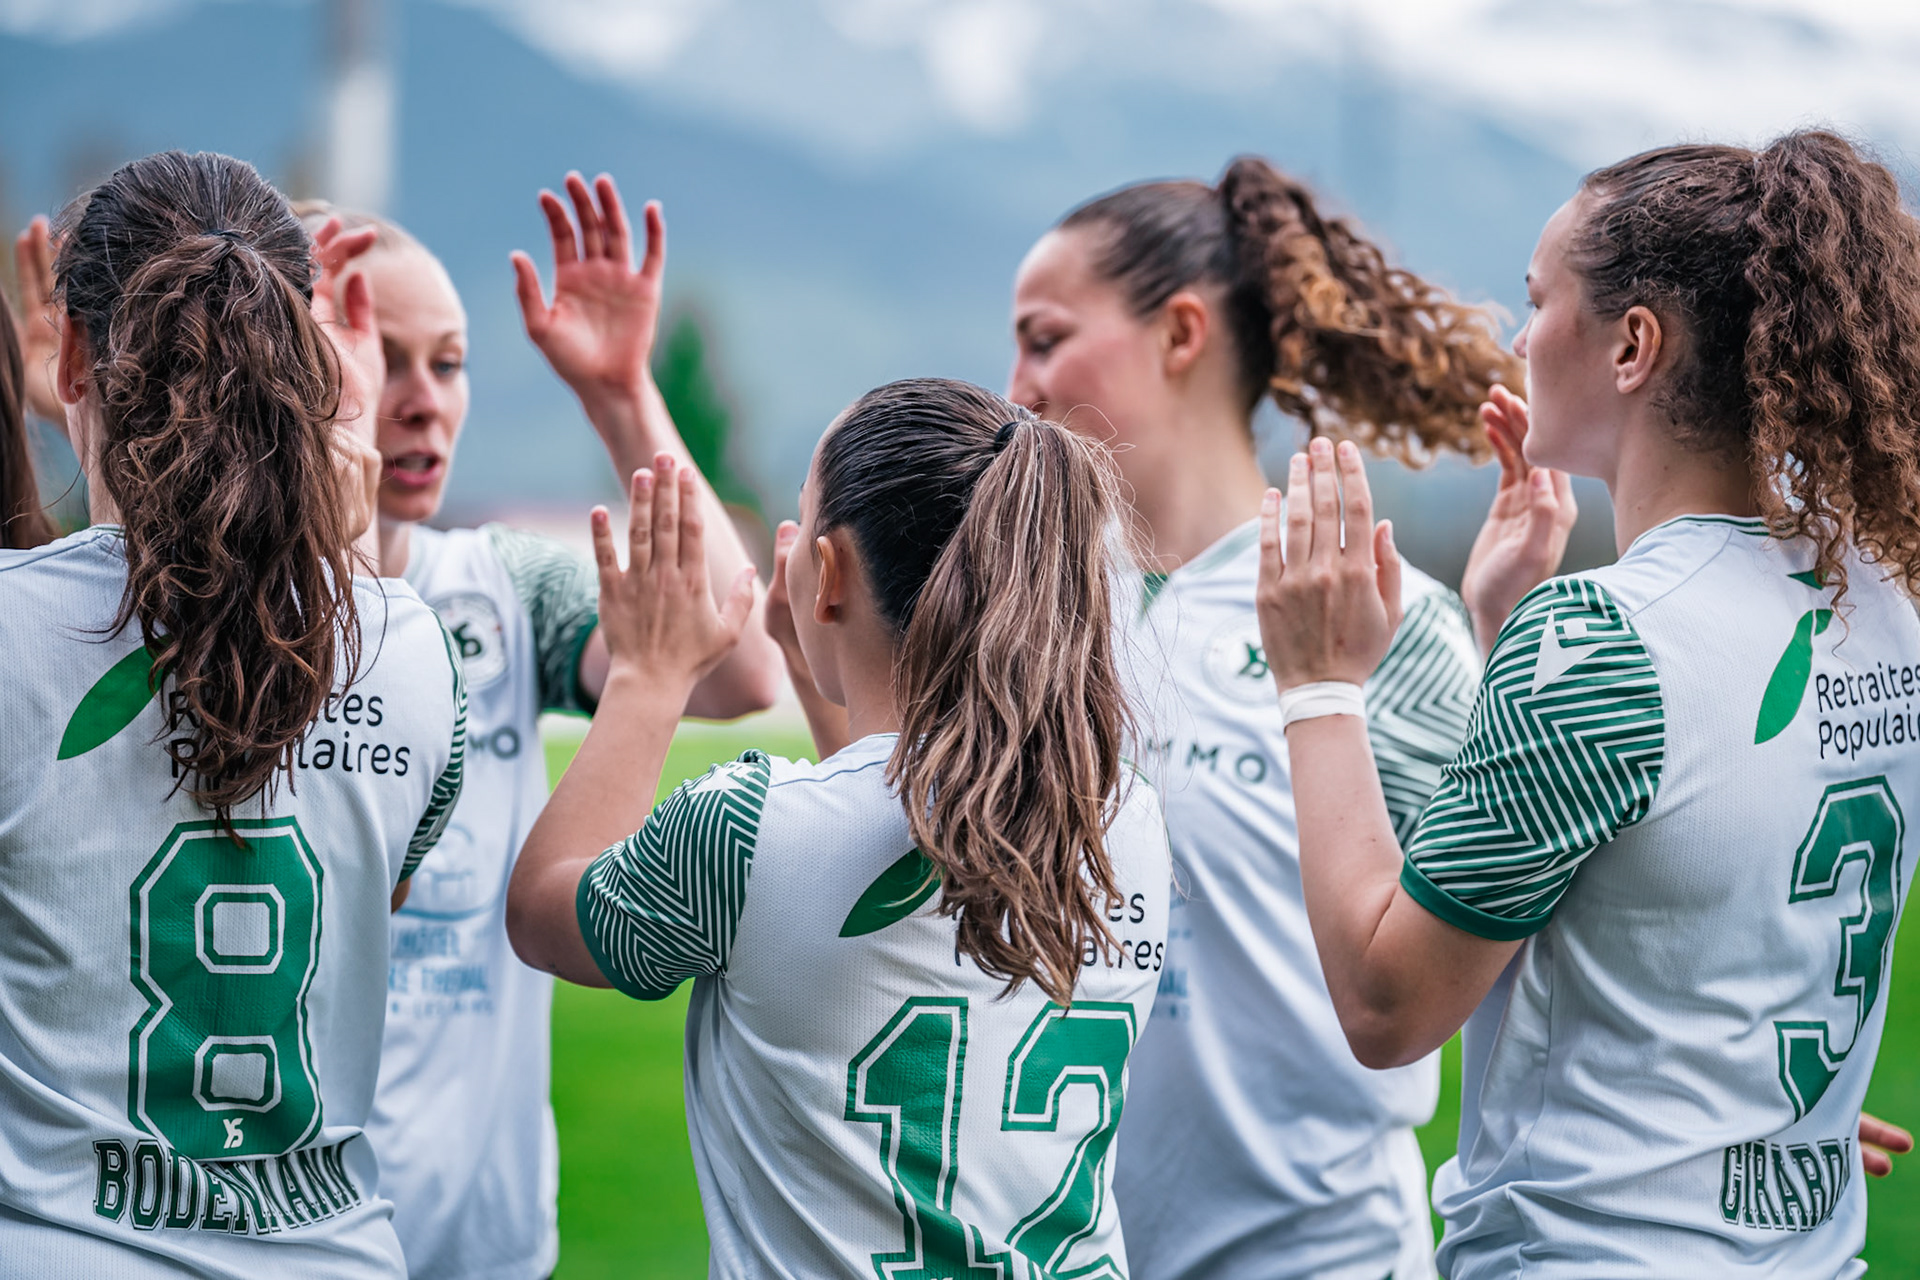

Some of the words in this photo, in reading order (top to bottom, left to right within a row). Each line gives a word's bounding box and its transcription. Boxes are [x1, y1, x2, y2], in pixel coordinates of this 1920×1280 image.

[129, 816, 324, 1161] 8
[1774, 775, 1905, 1122] 3
[844, 996, 1138, 1280] 12
